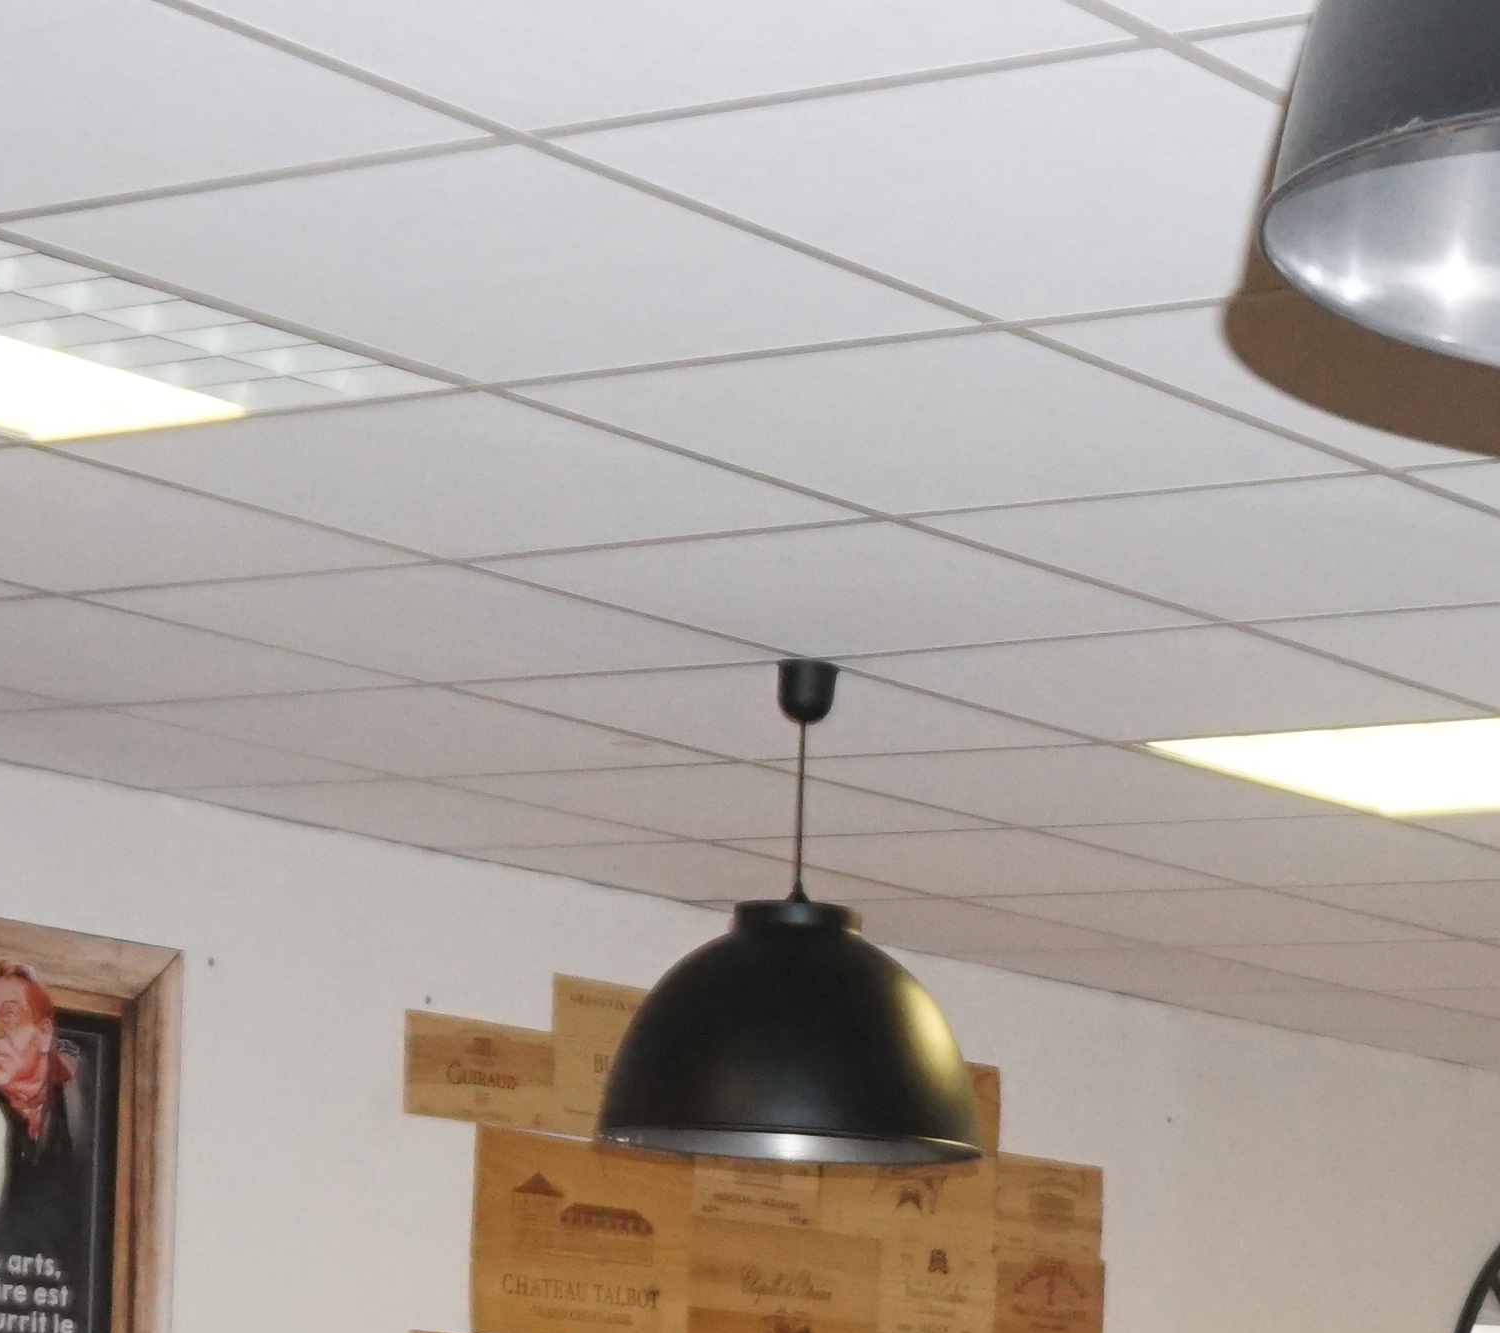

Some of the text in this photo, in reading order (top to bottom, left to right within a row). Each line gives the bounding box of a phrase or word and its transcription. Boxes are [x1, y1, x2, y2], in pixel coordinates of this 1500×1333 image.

[7, 1253, 62, 1279] arts,
[33, 1285, 69, 1307] est
[593, 1284, 661, 1310] TALBOT
